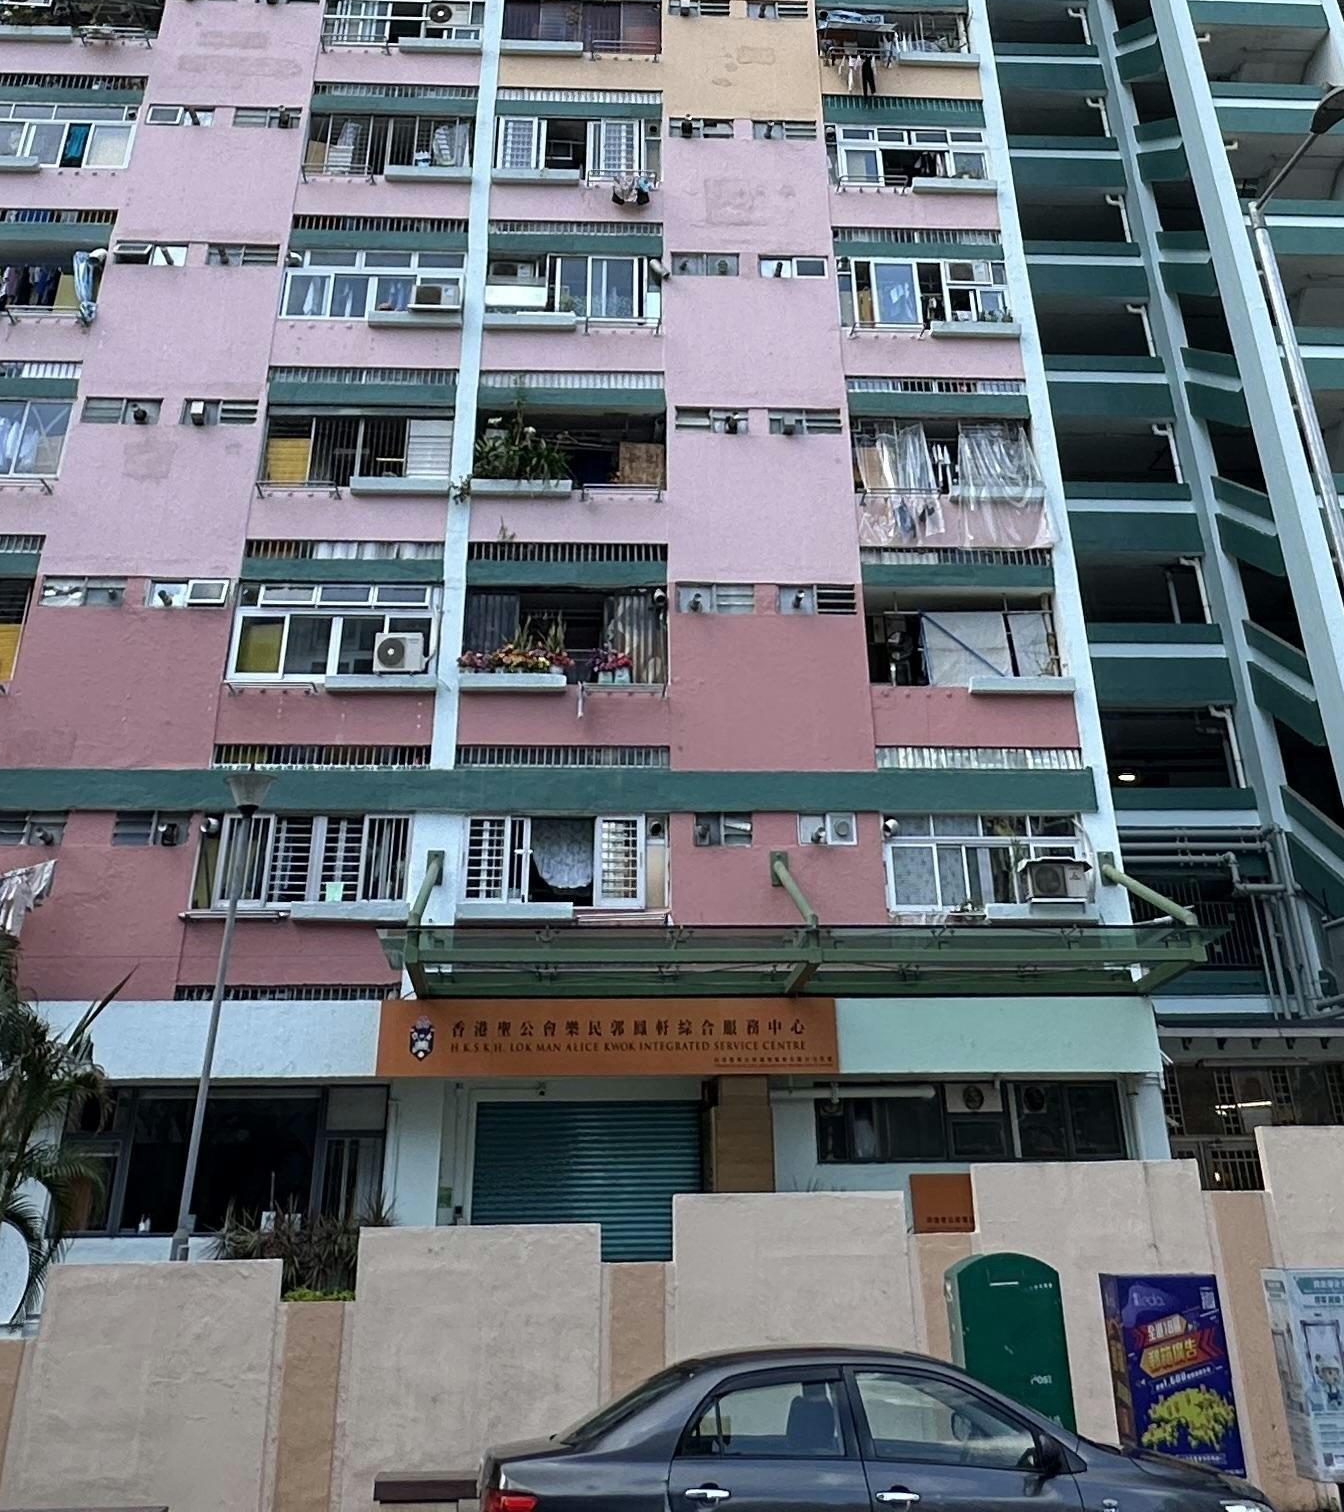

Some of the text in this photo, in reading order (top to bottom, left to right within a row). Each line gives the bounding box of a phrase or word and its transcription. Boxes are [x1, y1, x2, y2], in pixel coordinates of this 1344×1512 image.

[451, 1018, 806, 1039] 香港聖公會樂民郭鳳軒綜合服務中心
[509, 1042, 533, 1053] LOK
[536, 1042, 561, 1053] MAN
[565, 1041, 600, 1053] ALICE
[604, 1041, 636, 1052] KWOK
[639, 1040, 710, 1052] INTEGRATED
[713, 1040, 758, 1051] SERVICE
[762, 1040, 806, 1051] CENTRE
